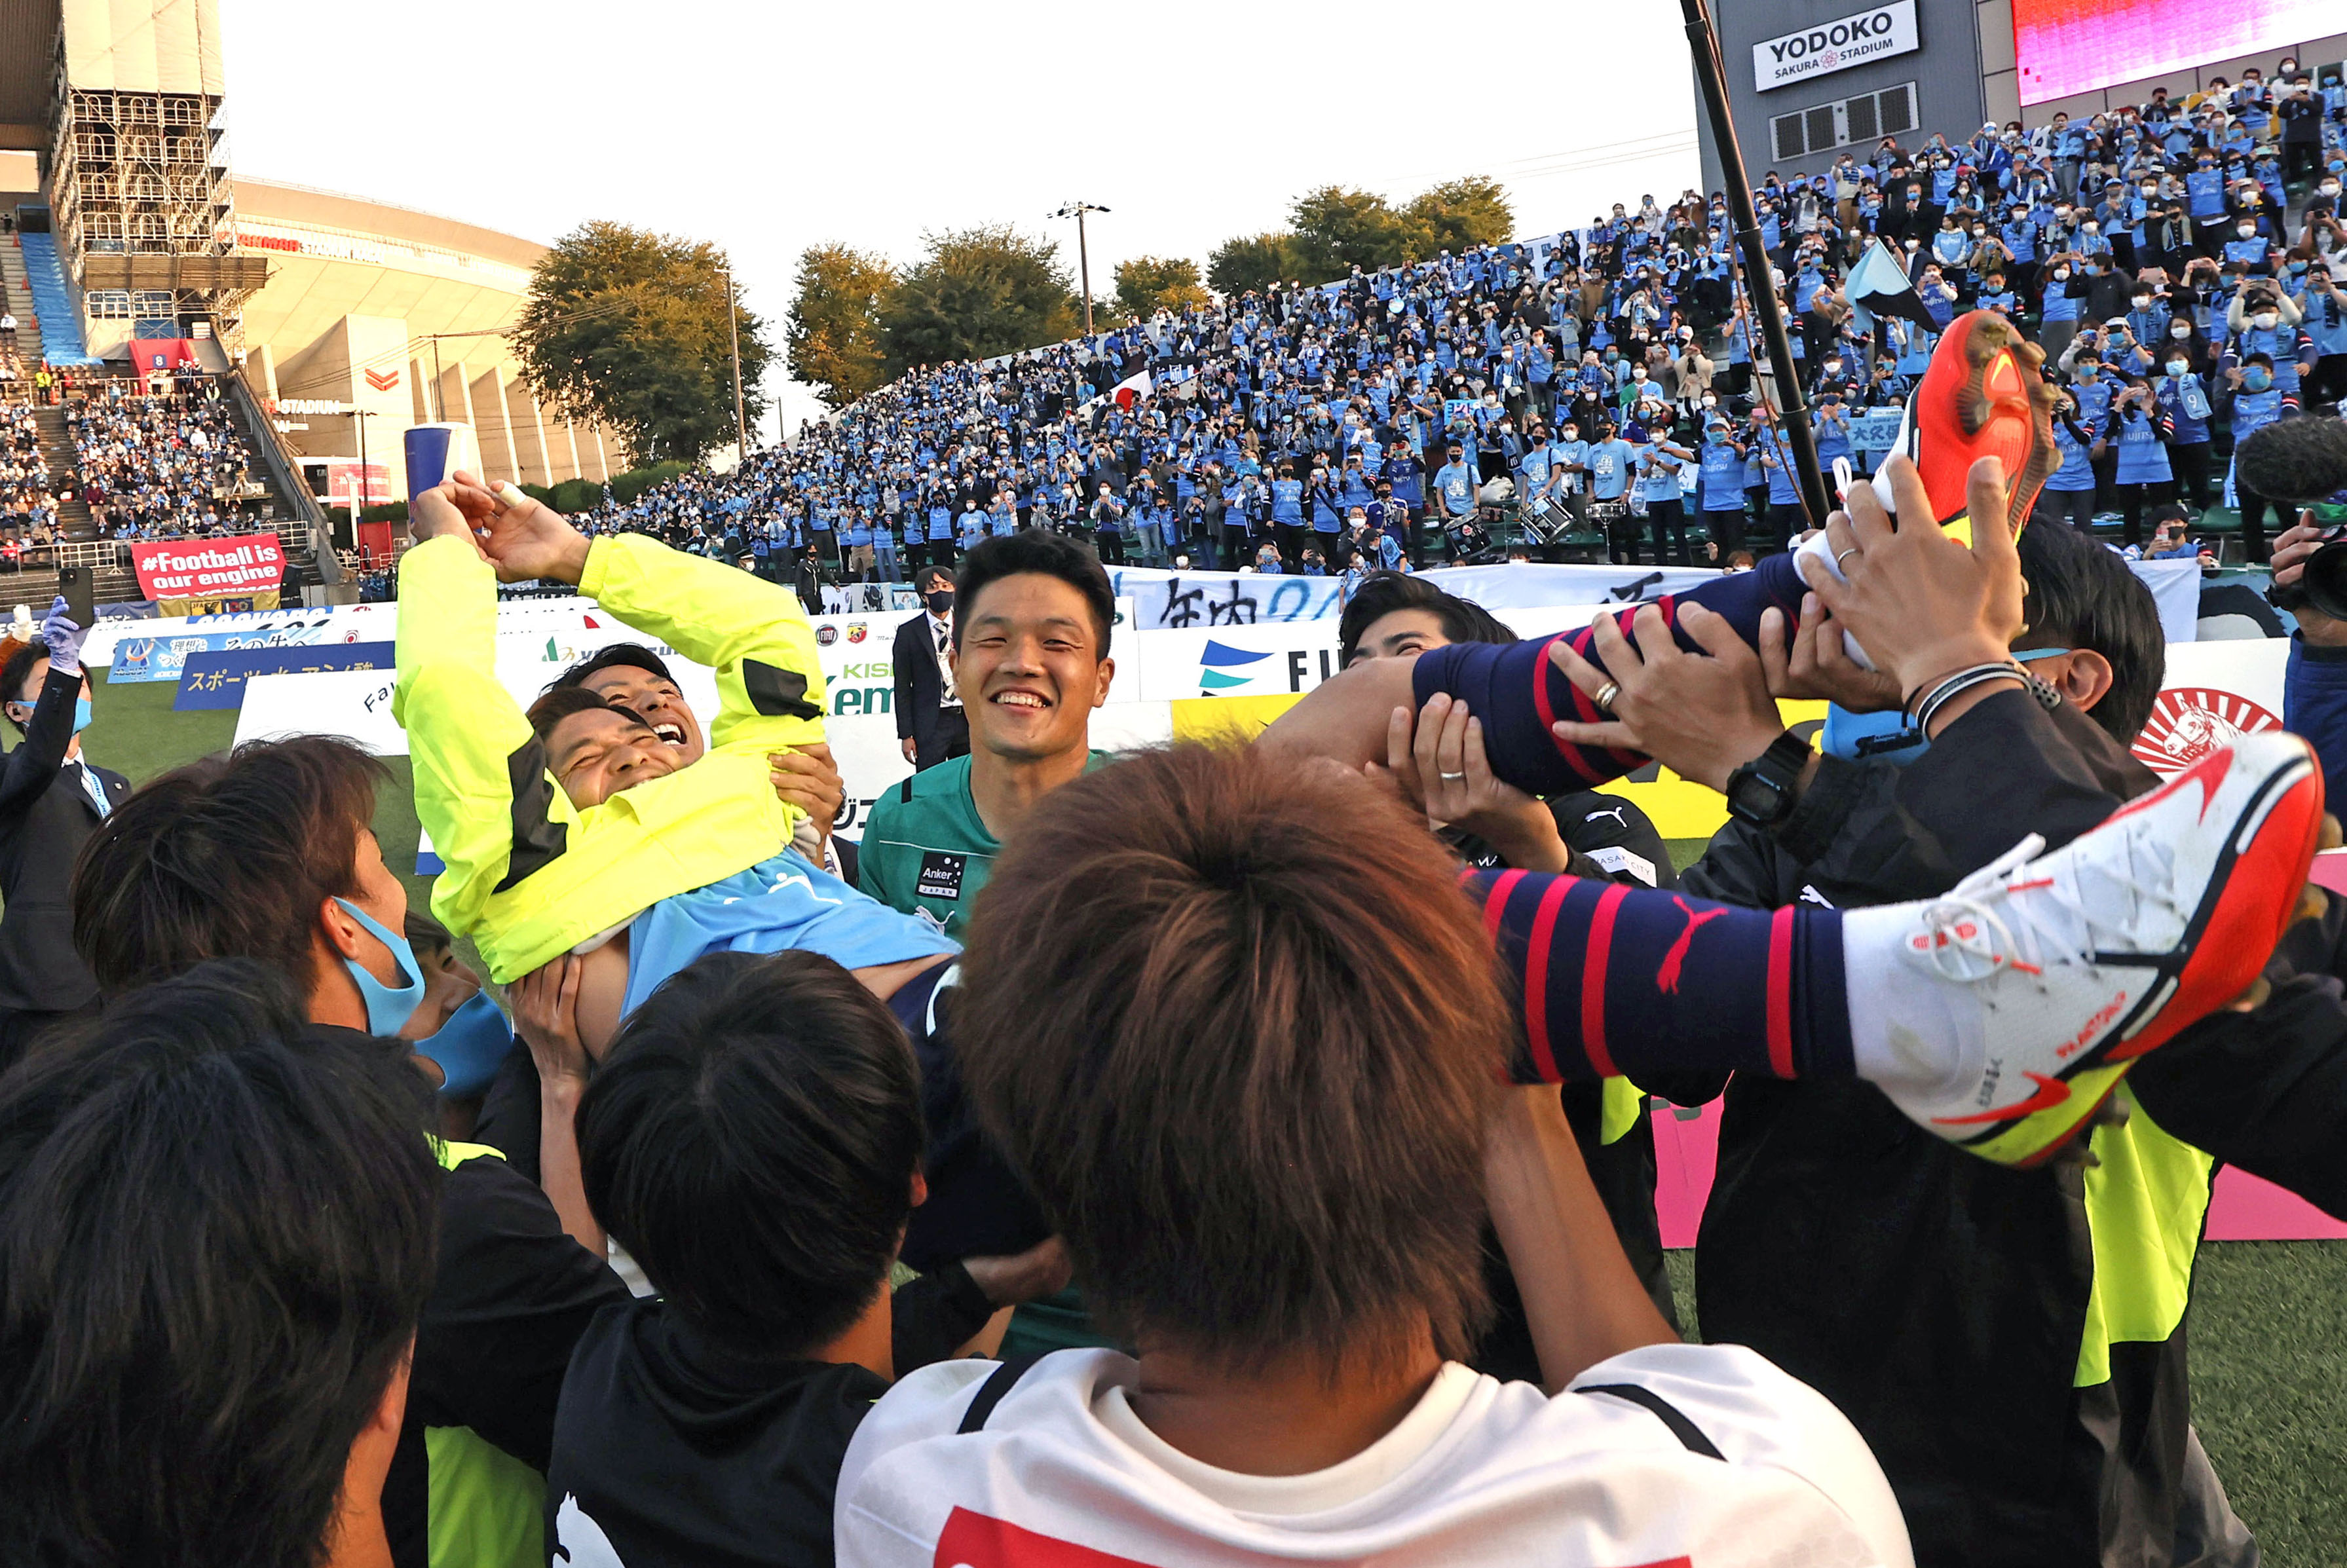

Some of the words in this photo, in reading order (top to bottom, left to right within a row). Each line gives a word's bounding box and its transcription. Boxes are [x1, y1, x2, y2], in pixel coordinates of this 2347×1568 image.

[1769, 12, 1892, 63] YODOKO
[1775, 59, 1820, 79] SAKURA
[1839, 38, 1893, 61] STADIUM
[155, 356, 163, 366] 8
[280, 399, 340, 415] STADIUM
[2187, 394, 2198, 409] 9
[141, 546, 254, 572] #Football
[253, 544, 278, 561] is
[153, 574, 193, 589] our
[197, 565, 278, 586] engine
[820, 629, 835, 642] FIAT
[844, 663, 894, 679] KIS
[1288, 649, 1343, 692] FI
[922, 867, 953, 880] Anker
[1630, 861, 1650, 875] CITY
[922, 887, 952, 895] JAPAN
